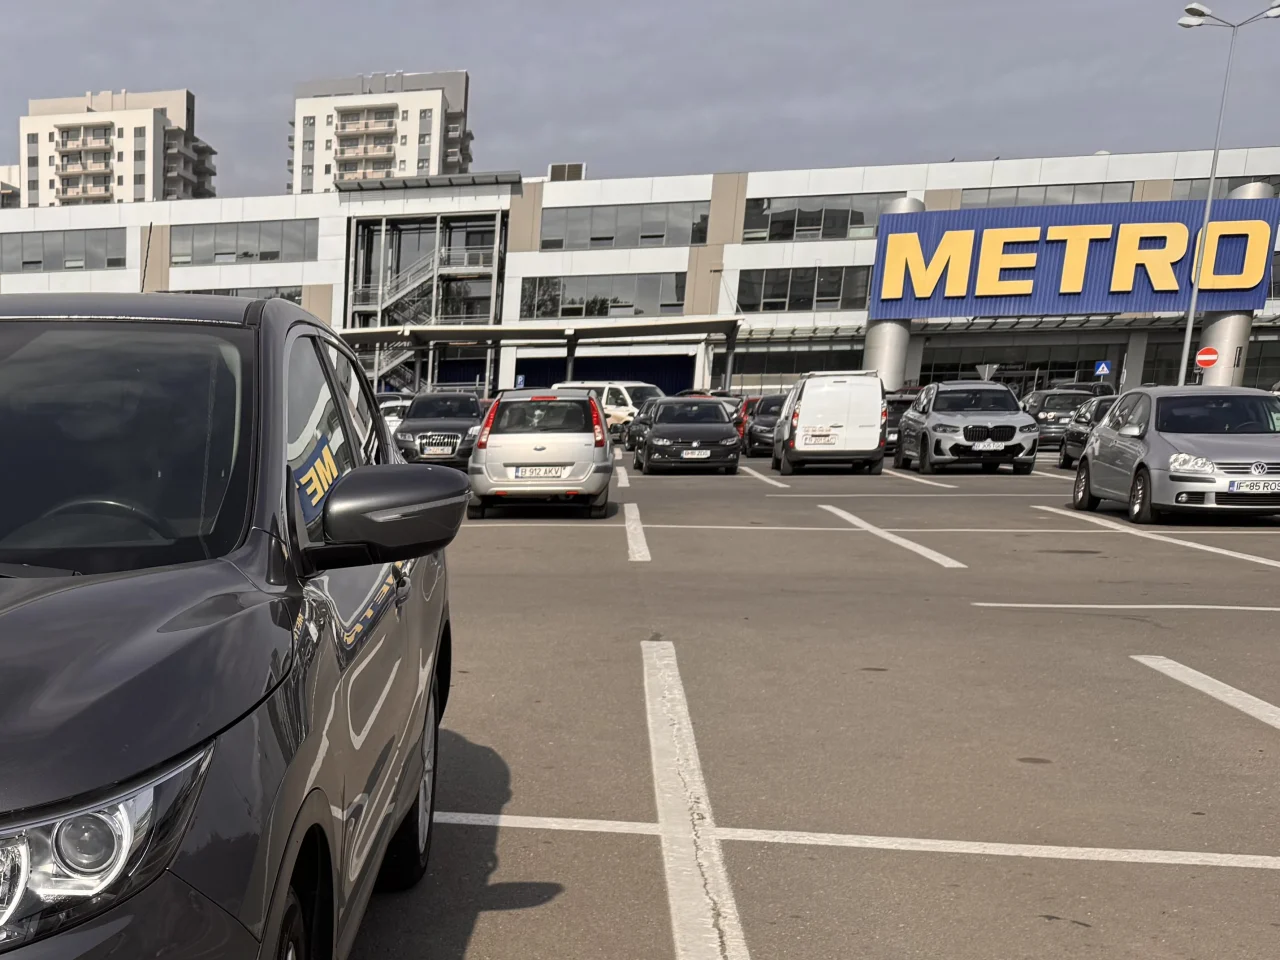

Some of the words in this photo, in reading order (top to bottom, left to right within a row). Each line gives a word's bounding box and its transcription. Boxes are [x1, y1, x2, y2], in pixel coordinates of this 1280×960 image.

[881, 219, 1271, 300] METRO
[528, 468, 542, 476] 912
[543, 467, 560, 476] AKV
[1236, 481, 1246, 491] IF
[1249, 481, 1261, 491] 85
